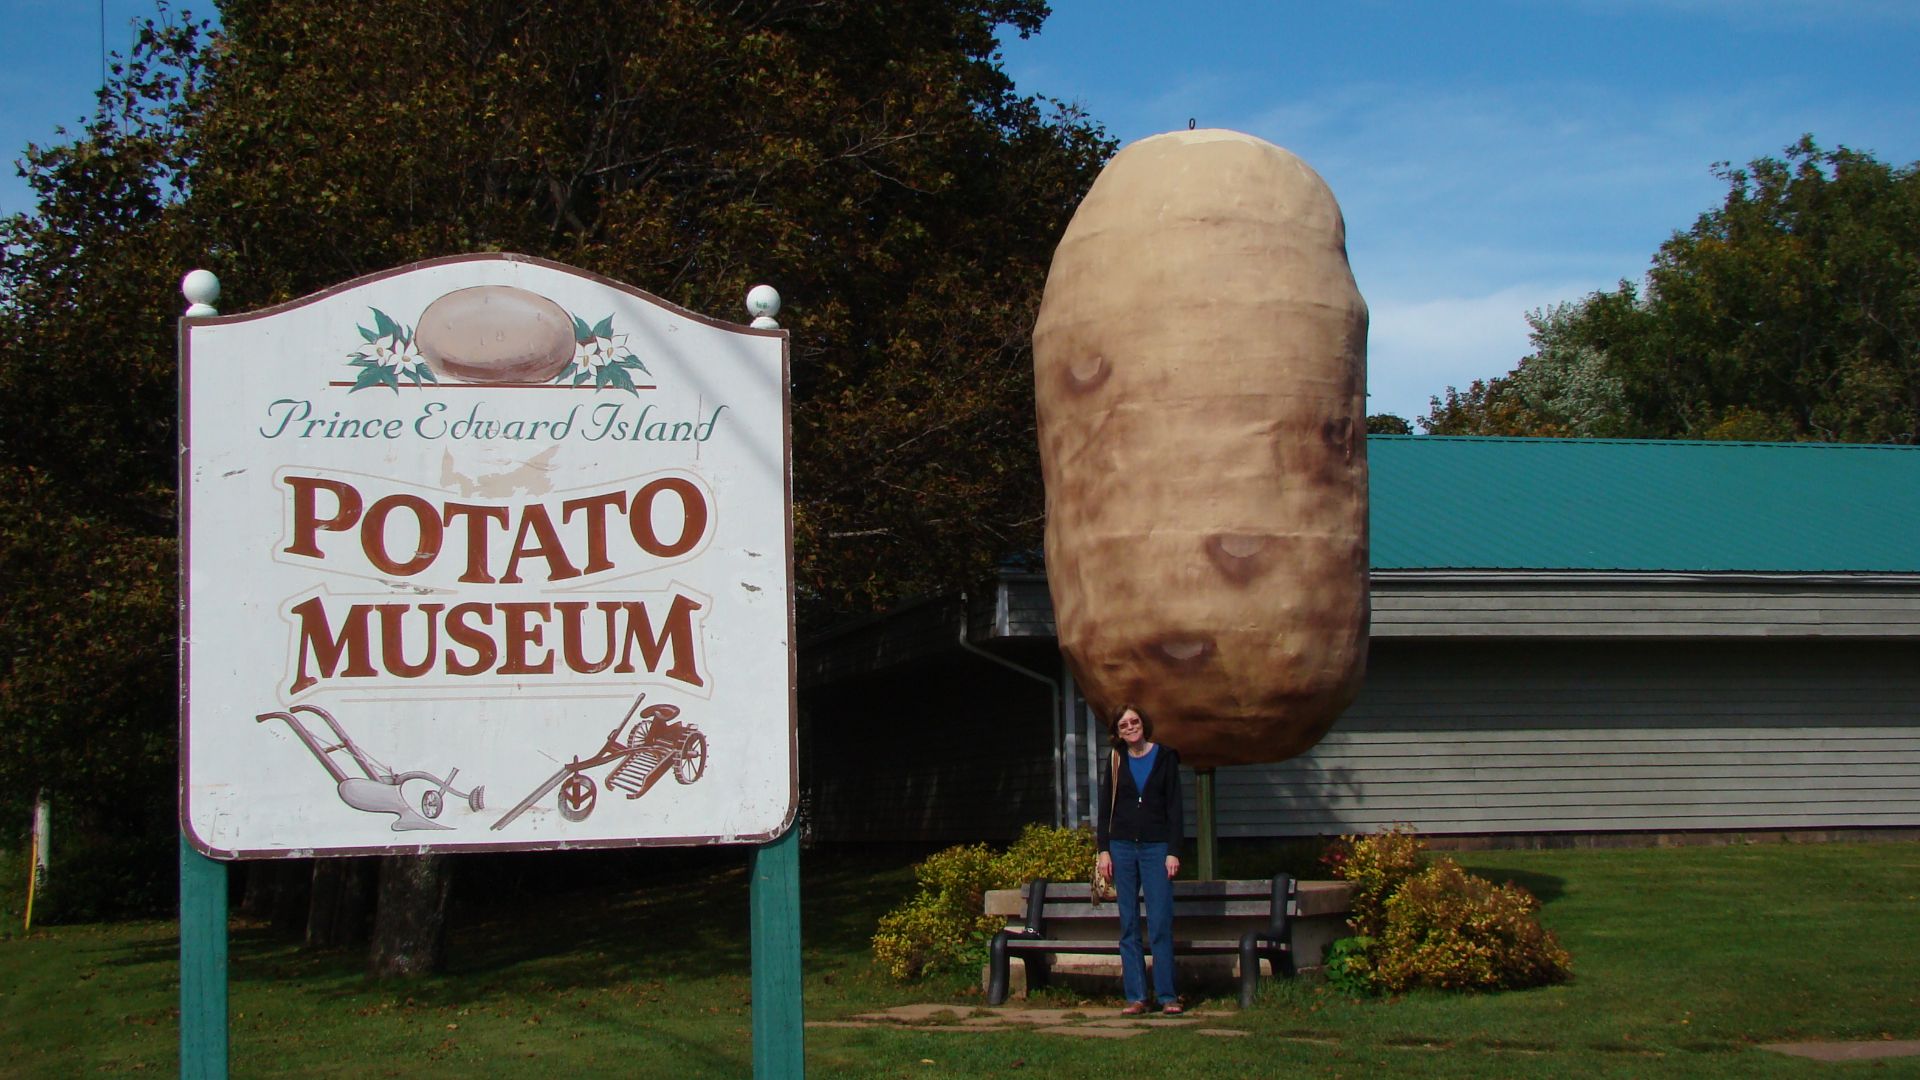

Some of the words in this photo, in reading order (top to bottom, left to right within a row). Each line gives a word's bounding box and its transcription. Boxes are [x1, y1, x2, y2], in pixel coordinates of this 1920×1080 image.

[260, 398, 403, 440] Prince
[414, 401, 585, 440] Edward
[581, 403, 729, 442] Island
[284, 476, 708, 583] POTATO
[290, 594, 705, 695] MUSEUM
